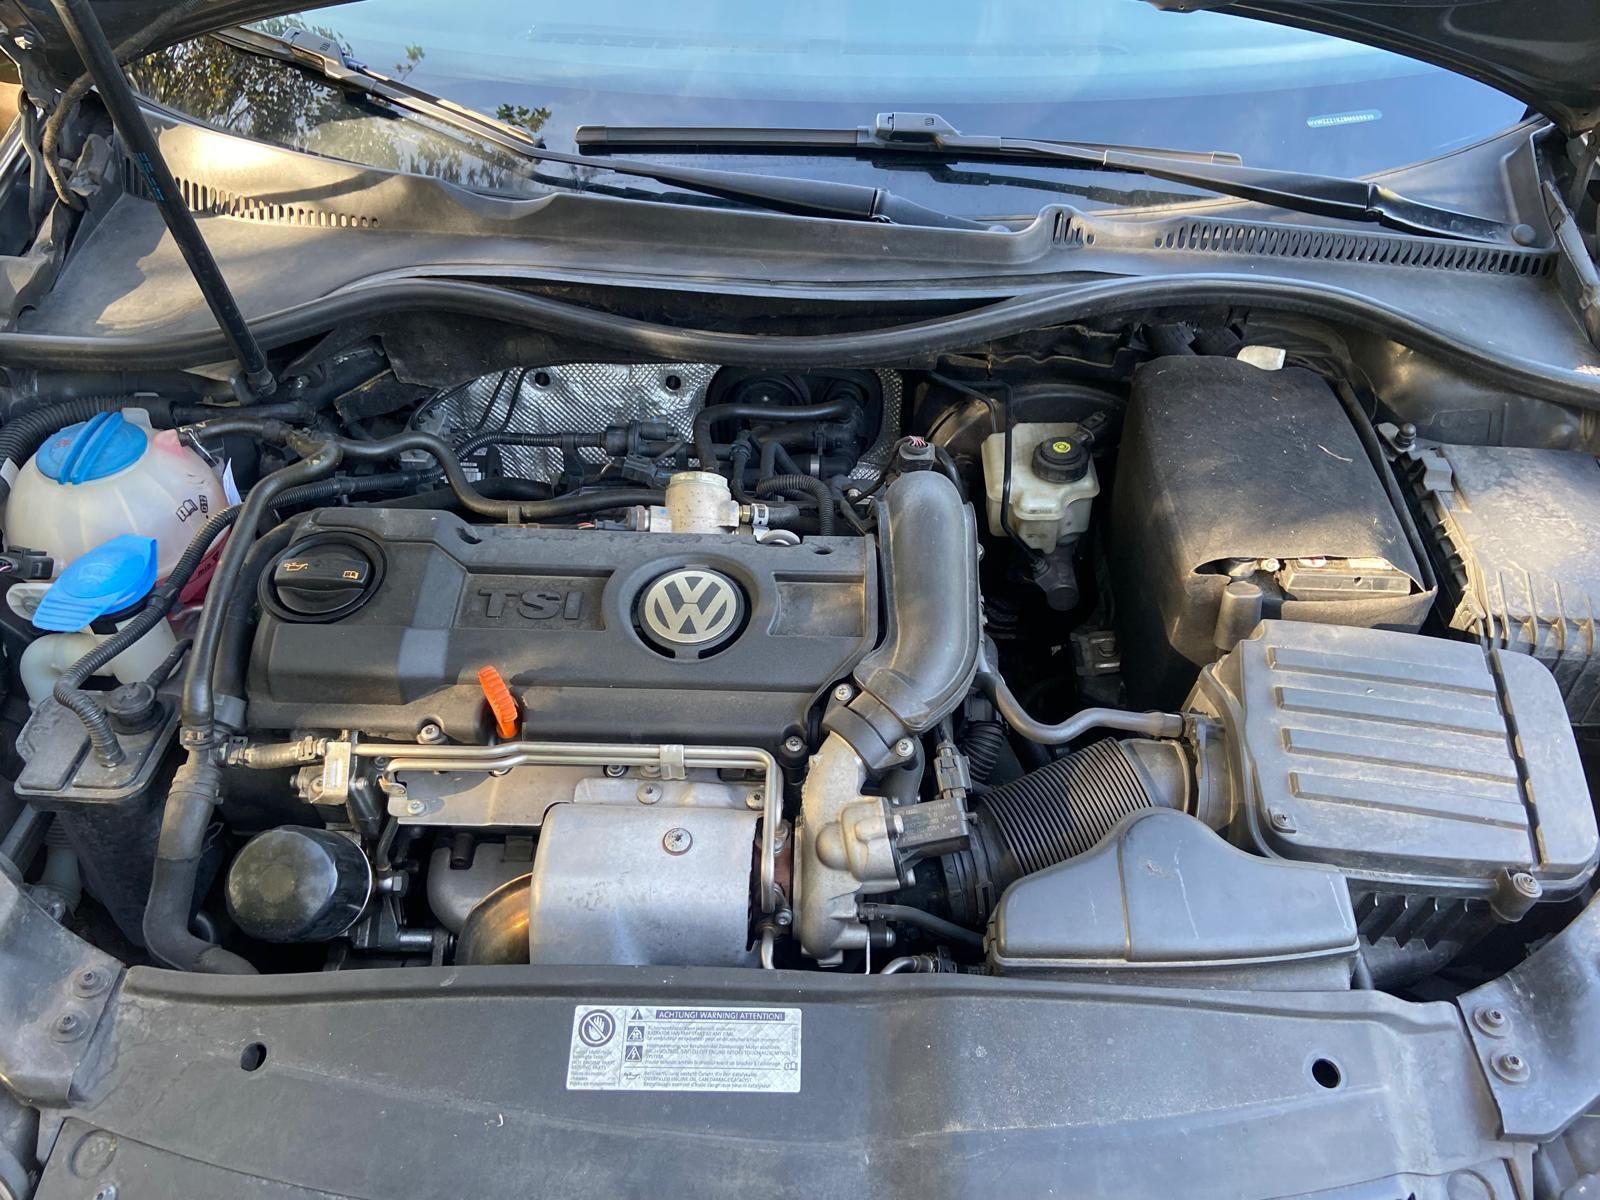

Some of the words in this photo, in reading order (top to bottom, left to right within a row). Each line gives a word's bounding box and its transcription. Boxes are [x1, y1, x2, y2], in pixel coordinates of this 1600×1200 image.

[478, 587, 584, 620] TSI
[659, 1011, 698, 1019] ACHTUNG!
[700, 1012, 739, 1020] WARNING!
